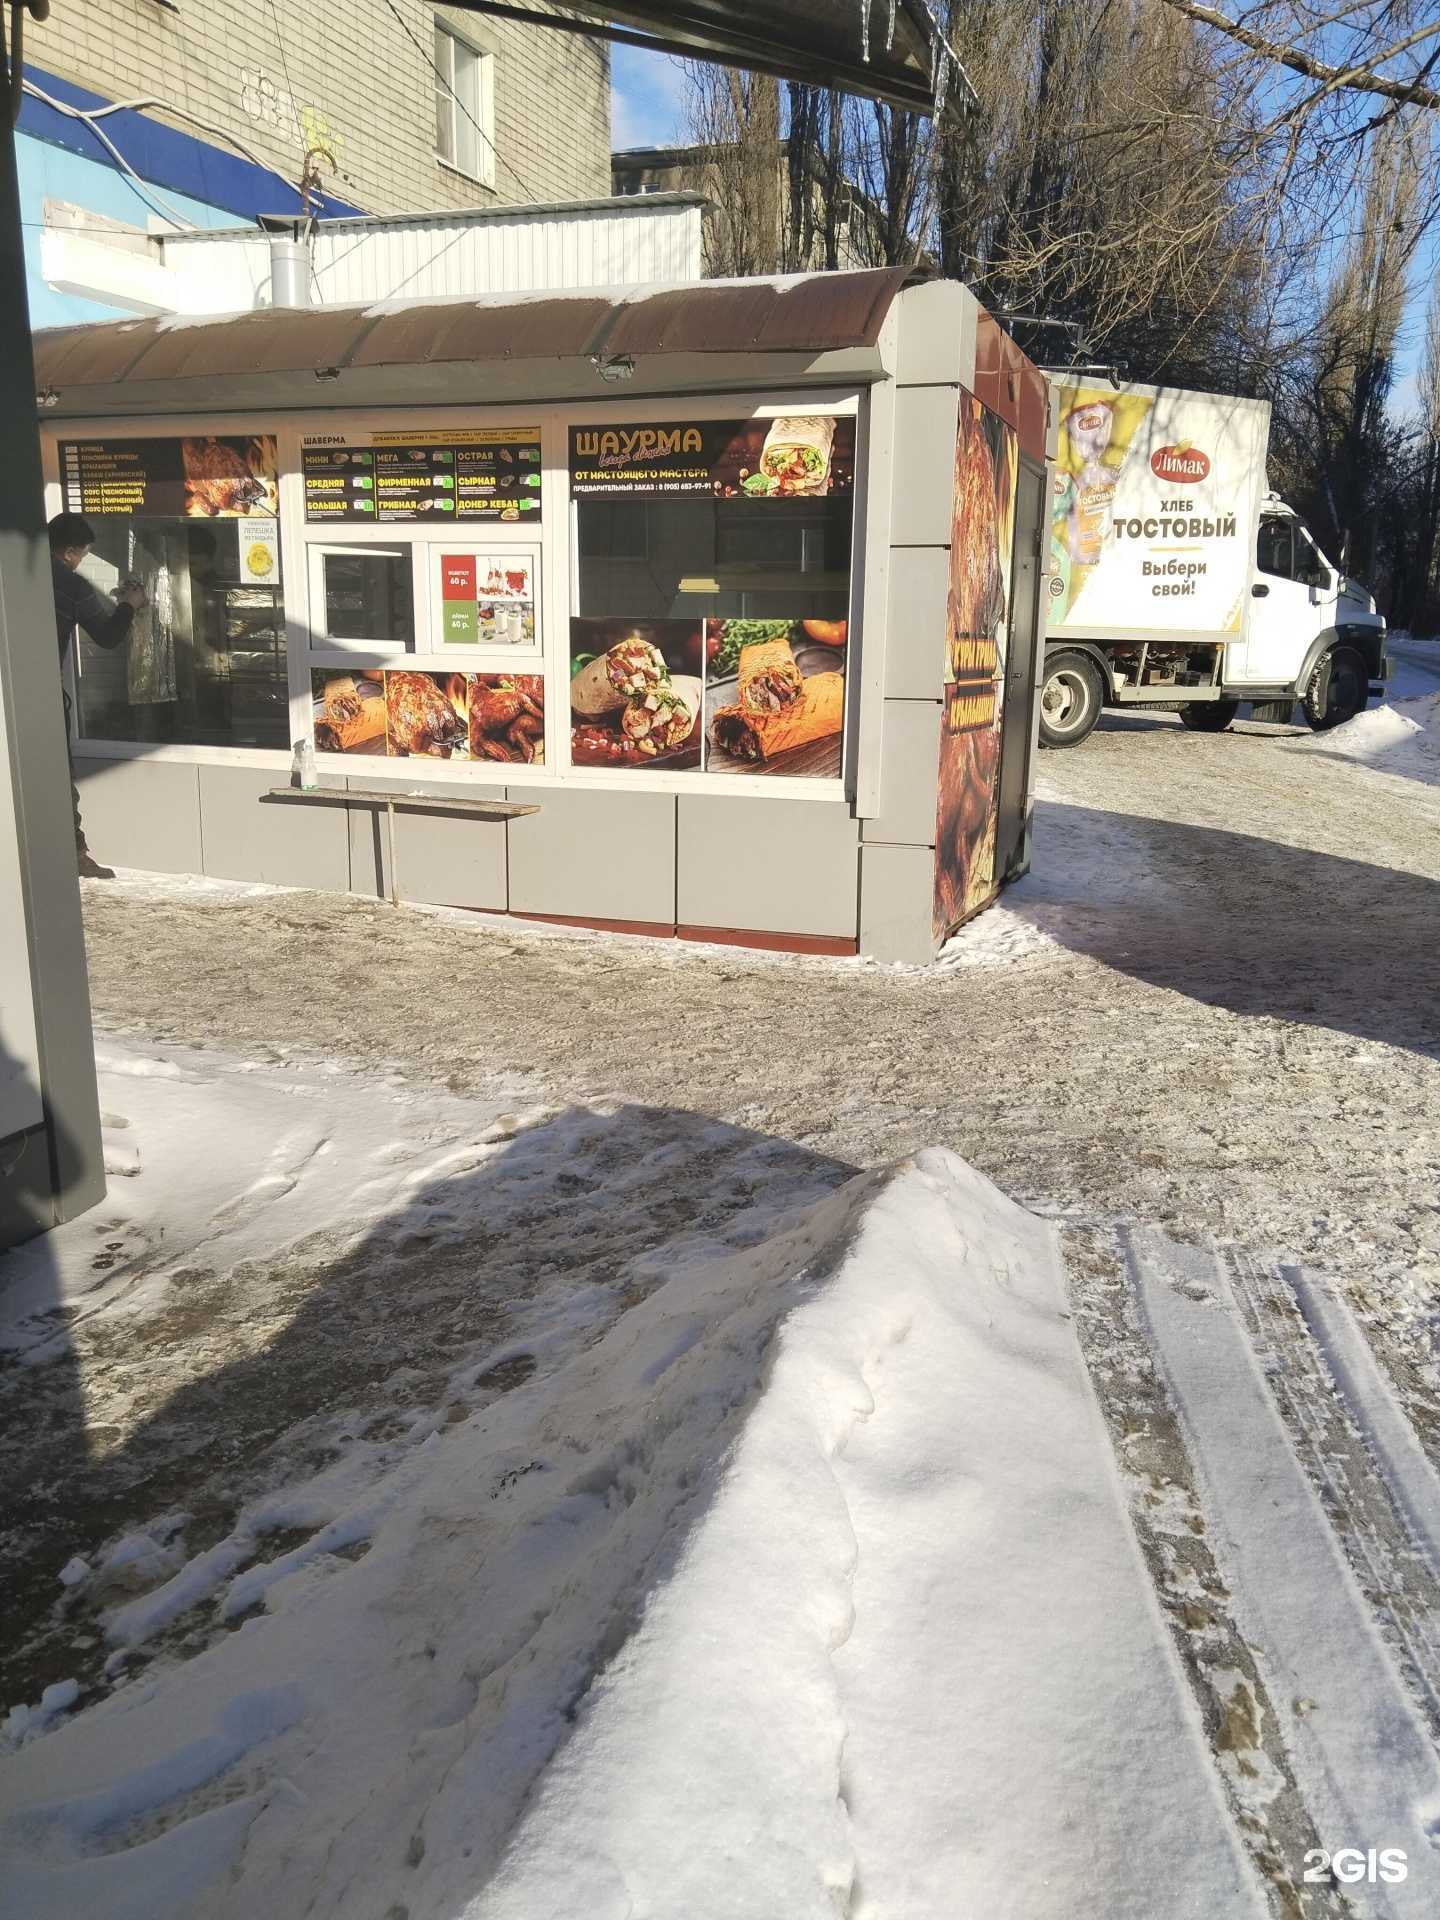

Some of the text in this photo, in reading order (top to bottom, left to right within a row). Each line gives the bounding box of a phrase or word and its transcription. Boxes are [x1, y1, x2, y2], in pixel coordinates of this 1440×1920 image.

[304, 436, 346, 445] ШАВЕРМА
[576, 429, 702, 455] ШАУРМА
[305, 456, 329, 464] МИНИ
[377, 454, 399, 463] МЕГА
[457, 452, 494, 460] ОСТРАЯ
[1156, 453, 1206, 476] Лимак
[575, 468, 708, 480] ОТ НАСТОЯЩЕГО МАСТЕРА
[306, 479, 345, 488] СРЕДНЯЯ
[377, 477, 431, 487] ФИРМЕННАЯ
[457, 477, 497, 485] СЫРНАЯ
[573, 483, 633, 492] ПРЕДВАРИТЕЛЬНЫЙ
[634, 483, 655, 491] ЗАКАЗ
[307, 501, 348, 510] БОЛЬШАЯ
[378, 501, 417, 509] ГРИБНАЯ
[458, 500, 488, 510] ДОНЕР
[489, 500, 519, 509] КЕБАБ
[1160, 500, 1194, 512] ХЛЕБ
[1112, 512, 1237, 539] ТОСТОВЫЙ
[1142, 559, 1207, 578] Выбери
[1151, 580, 1196, 597] свой!
